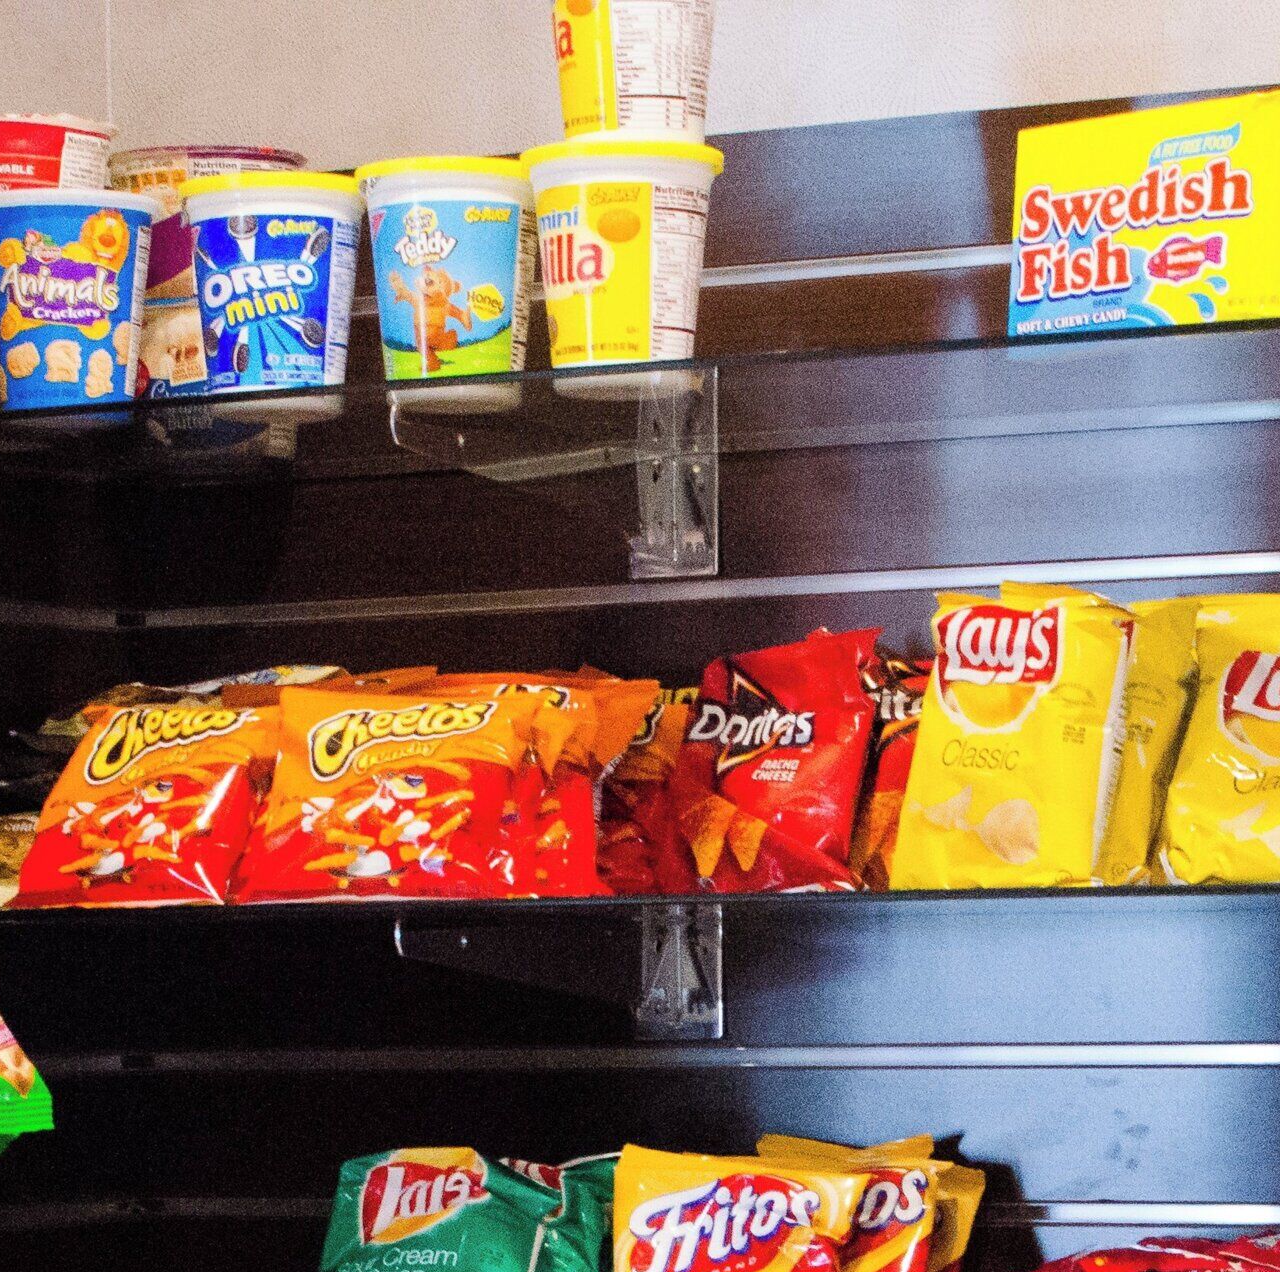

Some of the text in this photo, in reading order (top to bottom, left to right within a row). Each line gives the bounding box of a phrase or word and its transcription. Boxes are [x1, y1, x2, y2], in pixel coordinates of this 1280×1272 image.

[192, 161, 239, 170] Nutrition
[1020, 161, 1251, 240] Swedish
[393, 230, 458, 266] Teddy
[1019, 235, 1132, 298] Fish
[0, 263, 120, 312] Animals
[203, 263, 315, 309] OREO
[31, 306, 102, 320] Crackers
[226, 287, 300, 326] mini
[1053, 313, 1090, 330] CHEWY
[1092, 308, 1129, 324] CANDY
[942, 606, 1056, 685] Lay's
[86, 707, 245, 785] Cheetos
[308, 700, 499, 782] Cheetos
[689, 704, 816, 753] Doritos
[760, 758, 800, 771] NACHO
[940, 739, 1020, 771] Classic
[751, 769, 797, 783] CHEESE
[381, 1245, 459, 1271] Cream
